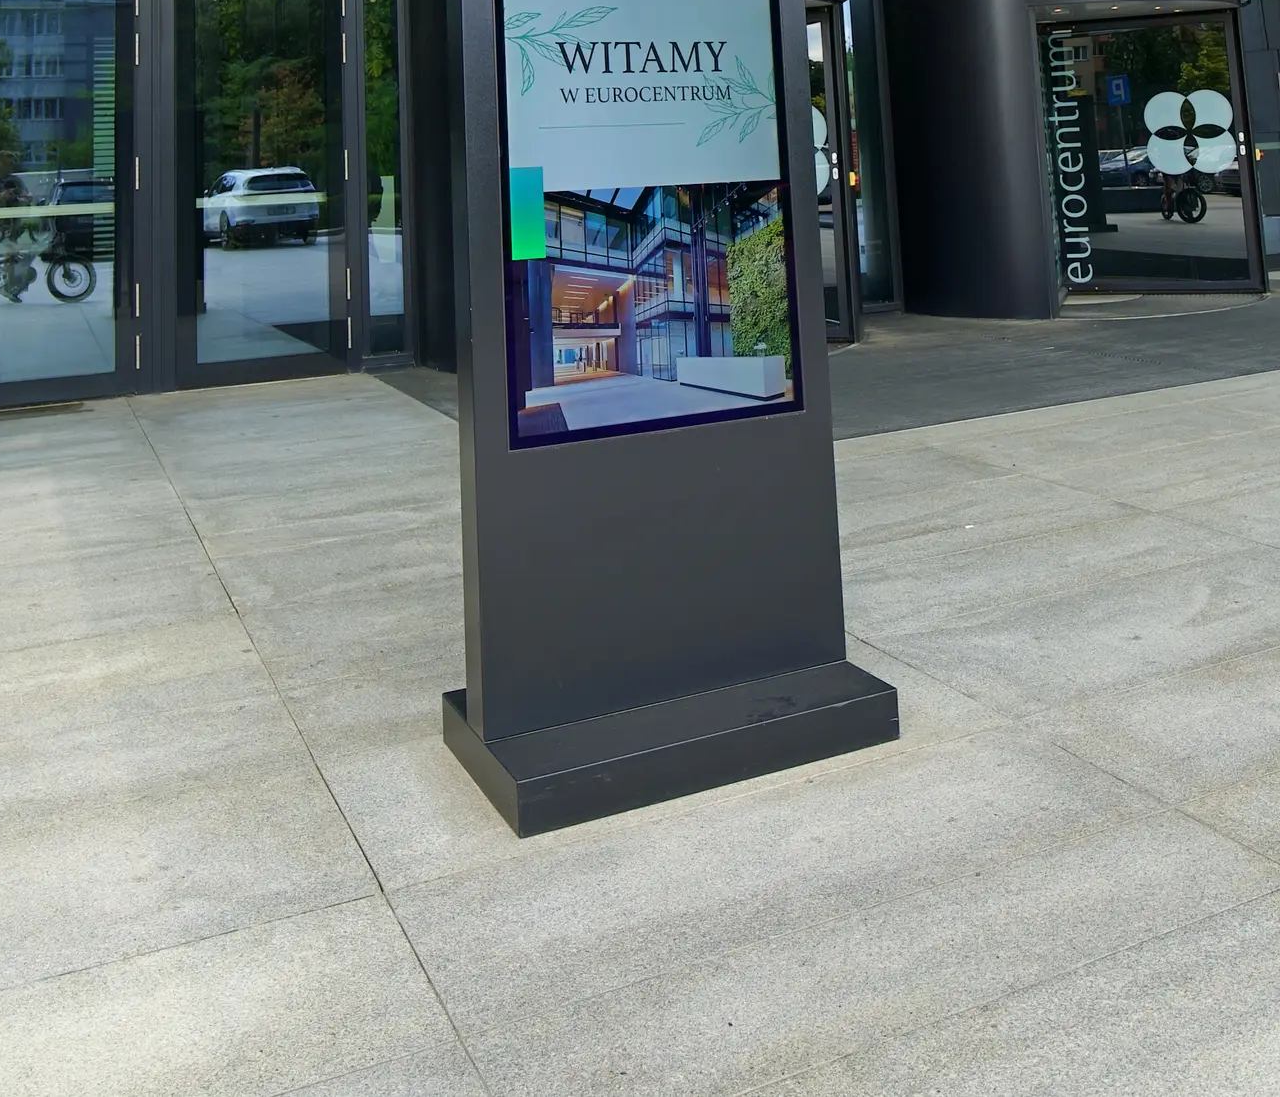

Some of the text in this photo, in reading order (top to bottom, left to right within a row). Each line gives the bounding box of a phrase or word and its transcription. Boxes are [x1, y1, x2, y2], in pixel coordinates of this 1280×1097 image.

[555, 41, 727, 74] WITAMY
[560, 85, 732, 104] W EUROCENTRUM
[1048, 29, 1094, 284] eurocentrum
